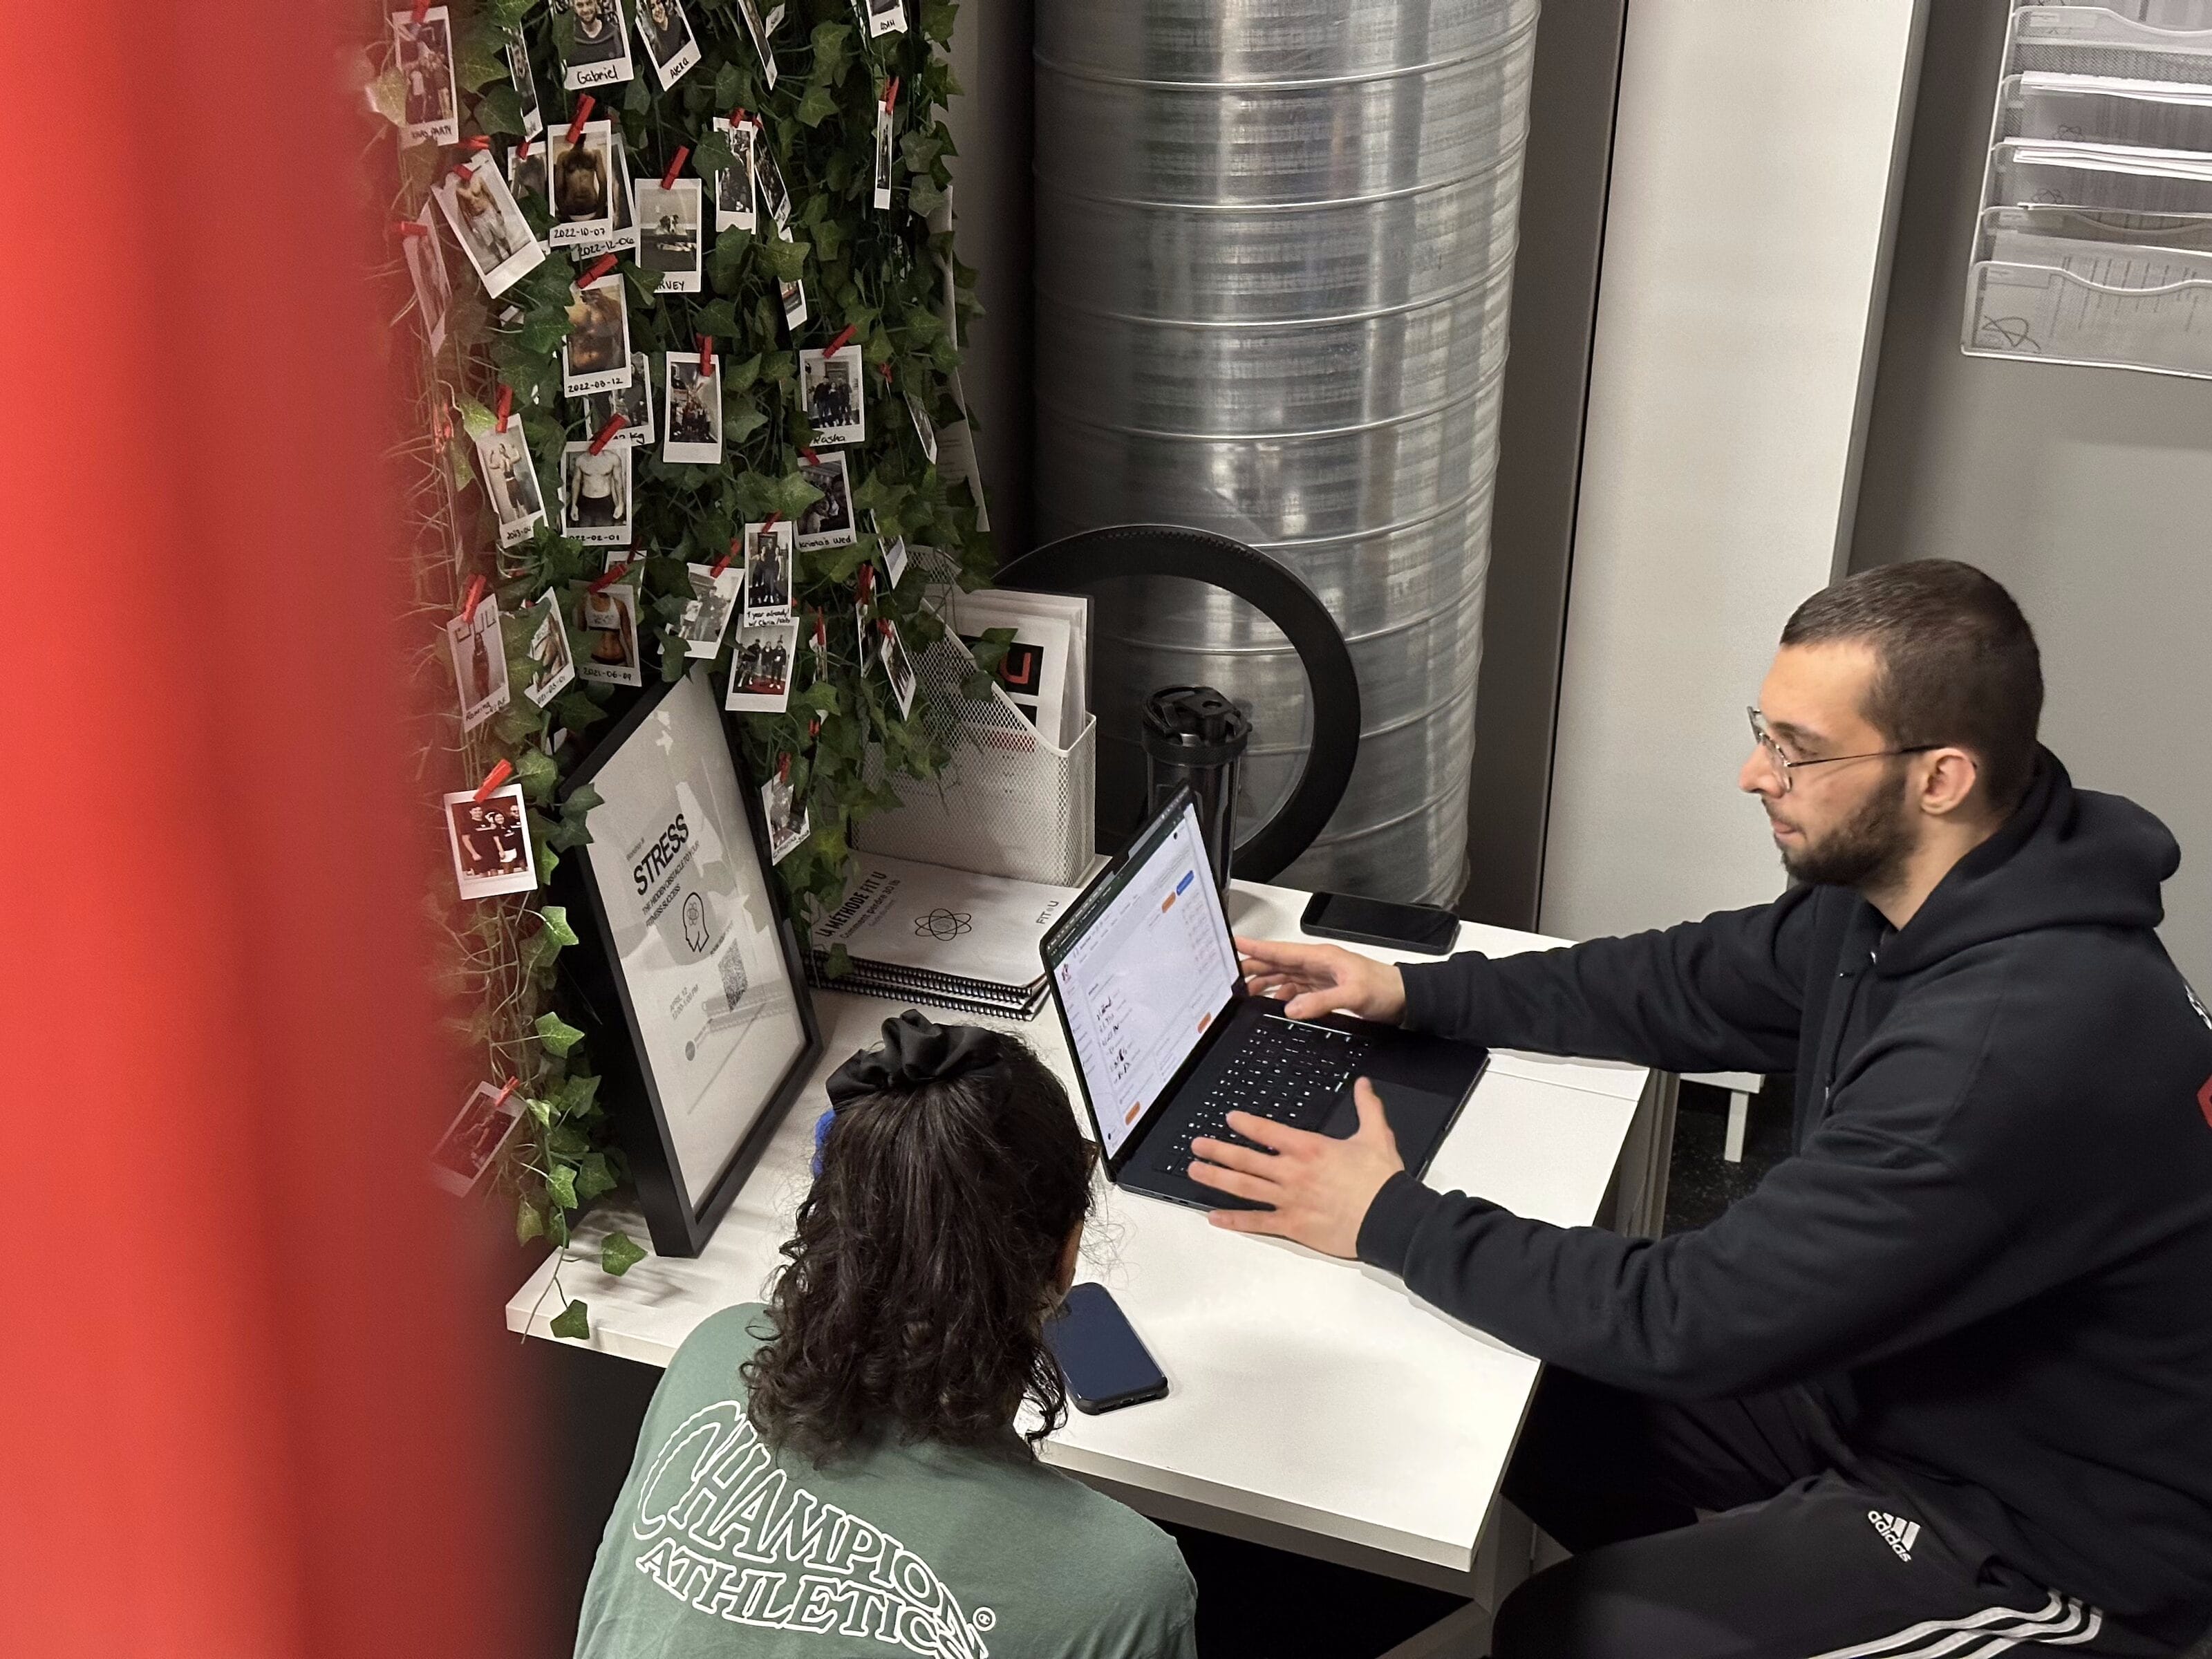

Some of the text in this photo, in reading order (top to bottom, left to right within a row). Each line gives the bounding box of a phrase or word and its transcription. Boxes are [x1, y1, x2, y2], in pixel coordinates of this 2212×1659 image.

[577, 64, 619, 84] Gabriel
[554, 228, 606, 238] 2022-10-07
[579, 238, 635, 256] 2022-12-06
[659, 280, 684, 291] RVEY
[834, 536, 851, 545] Wed
[633, 813, 689, 896] STRESS
[871, 871, 887, 879] U
[860, 879, 881, 894] FIT
[825, 891, 870, 930] MÉTHODE
[866, 894, 888, 914] perdre
[1035, 911, 1051, 924] FIT
[815, 928, 836, 937] LA
[1868, 1510, 1911, 1562] adidas
